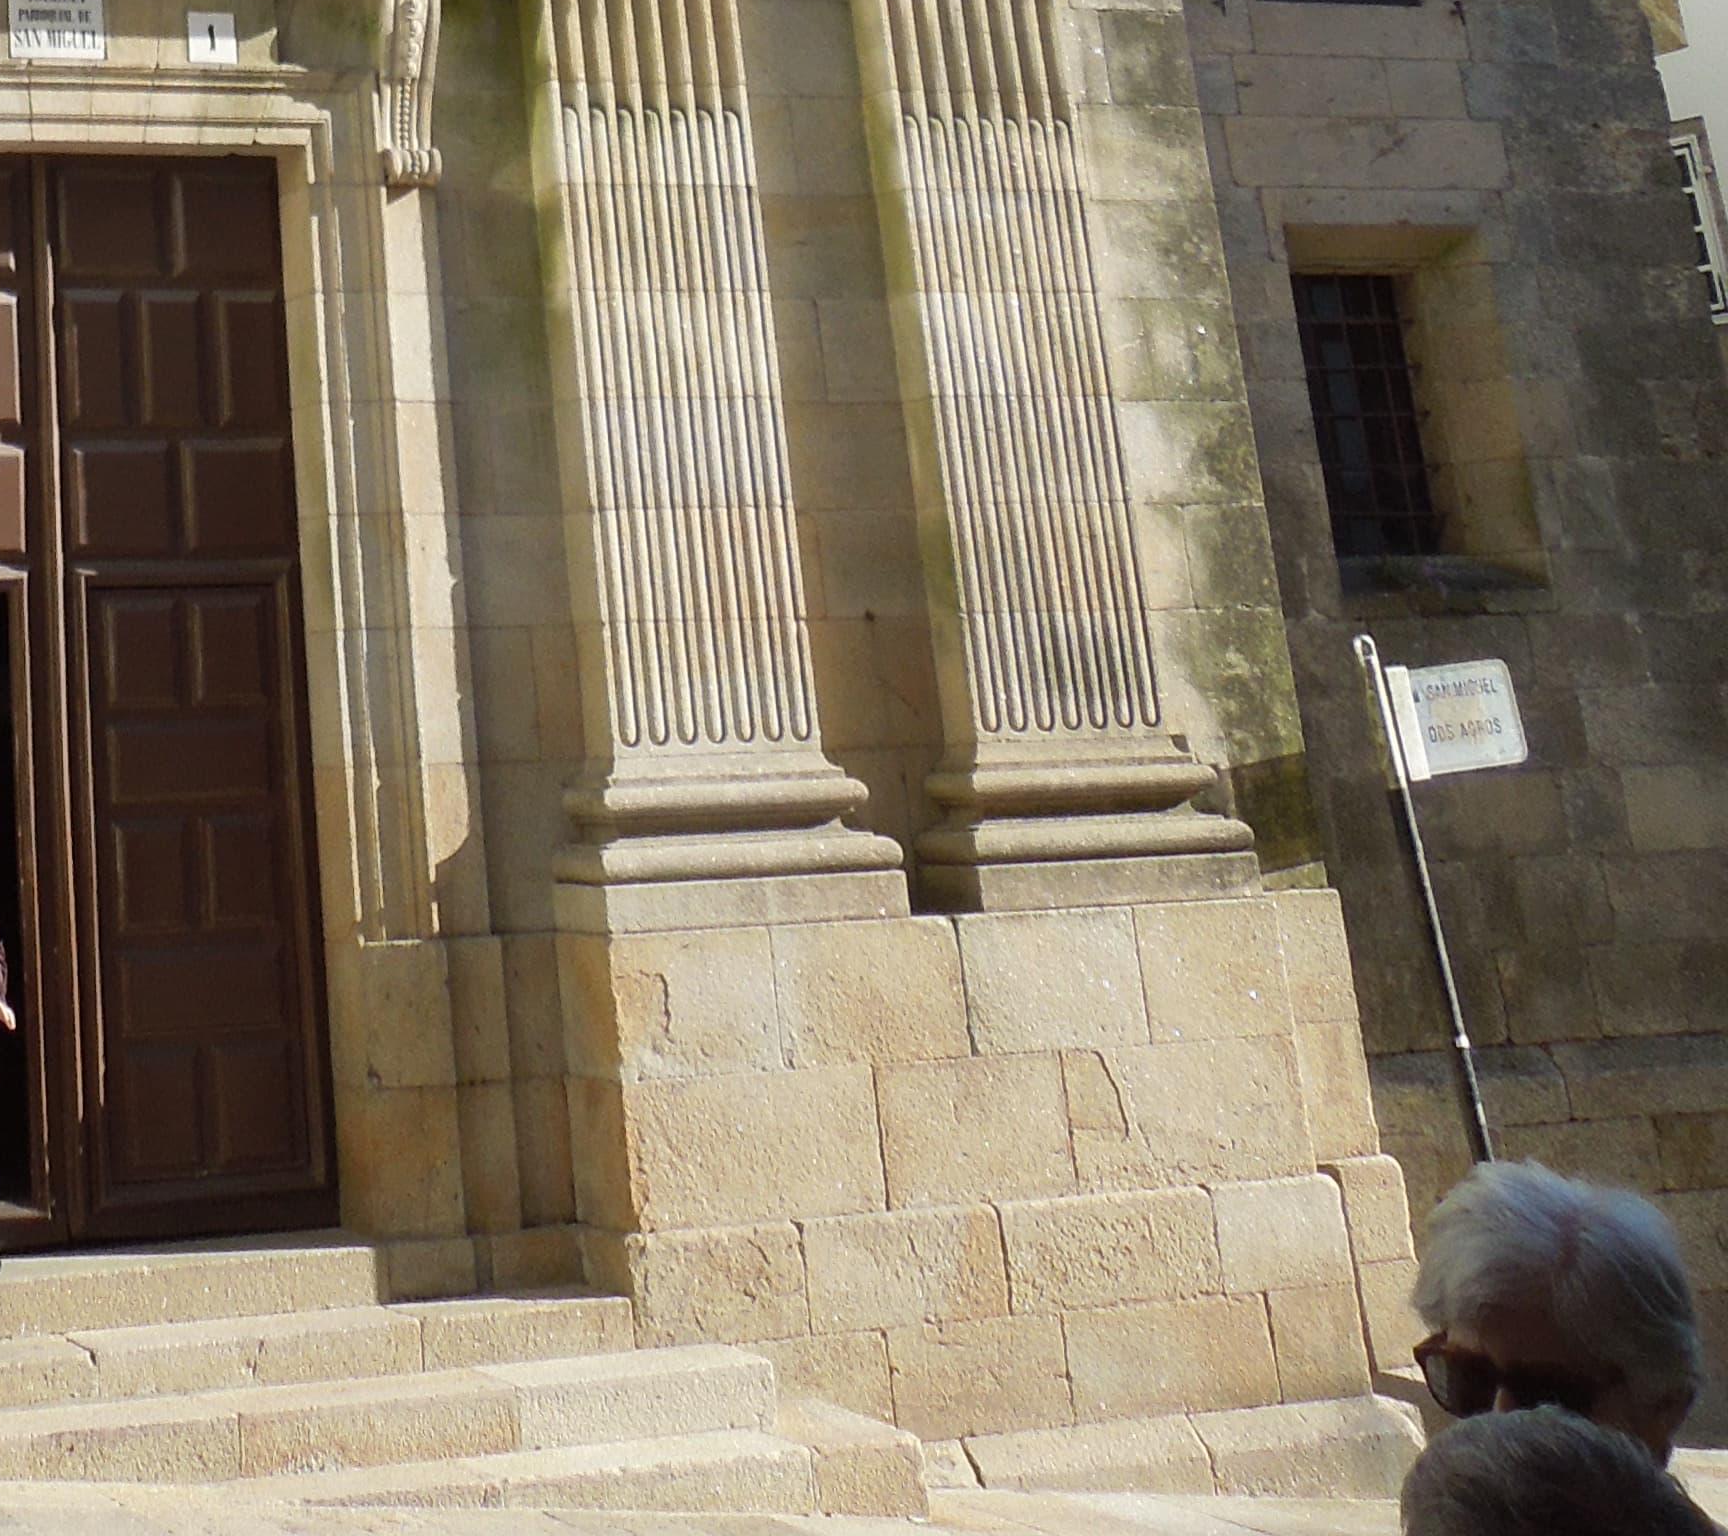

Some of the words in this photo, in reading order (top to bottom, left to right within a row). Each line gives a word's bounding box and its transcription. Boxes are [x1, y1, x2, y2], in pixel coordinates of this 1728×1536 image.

[78, 10, 92, 24] DE
[15, 28, 41, 48] SAN
[46, 29, 100, 49] MIGUEL
[207, 24, 216, 52] 1
[1426, 683, 1451, 700] SAN
[1453, 679, 1498, 697] MIGUEL
[1428, 724, 1455, 743] DOS
[1460, 716, 1502, 738] AGROS
